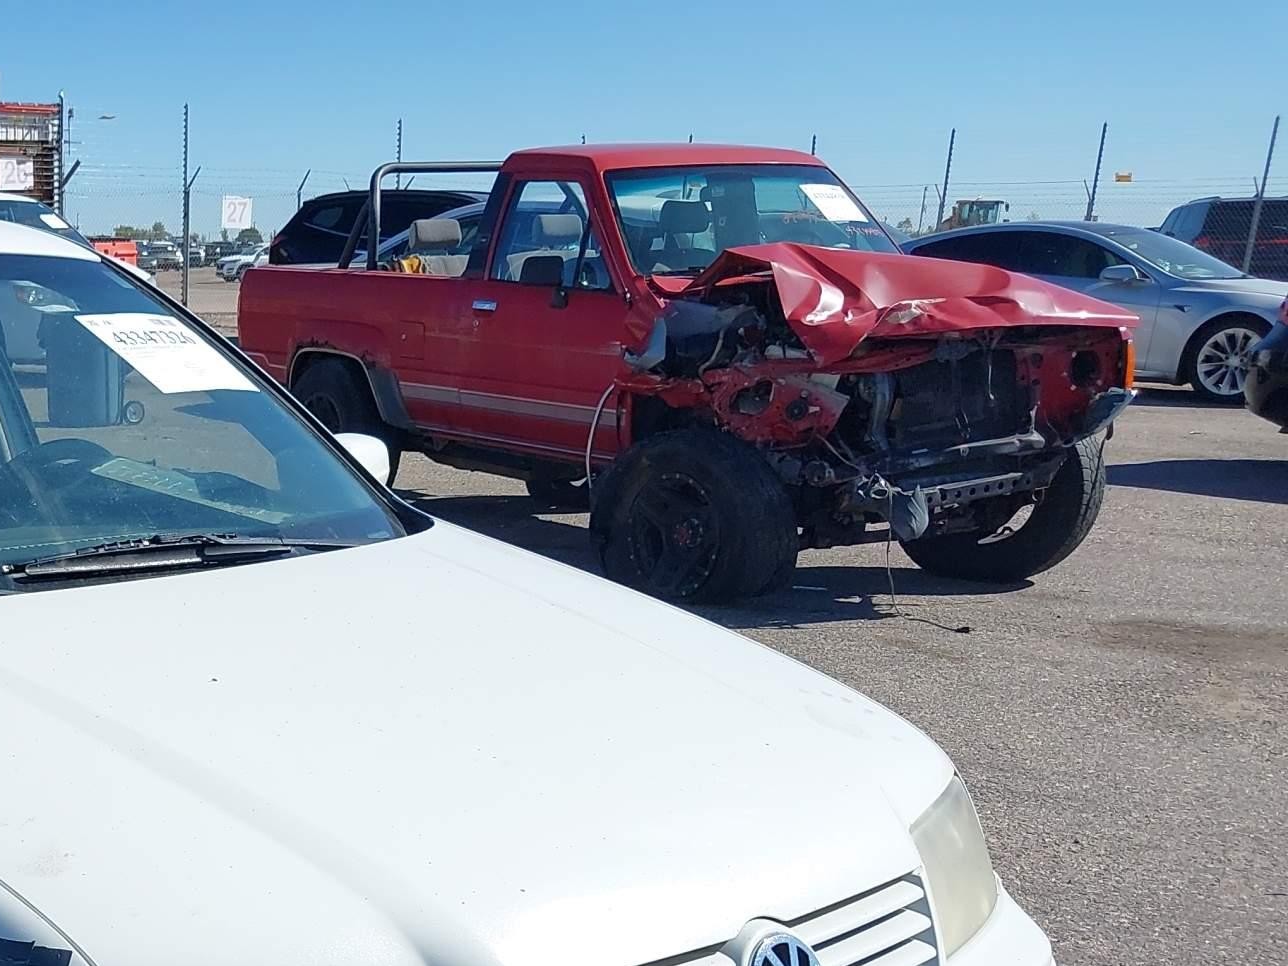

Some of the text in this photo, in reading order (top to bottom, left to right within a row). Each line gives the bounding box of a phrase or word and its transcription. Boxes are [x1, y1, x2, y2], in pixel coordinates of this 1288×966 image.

[4, 160, 28, 184] 26
[226, 201, 248, 223] 27
[112, 329, 197, 346] 43347326
